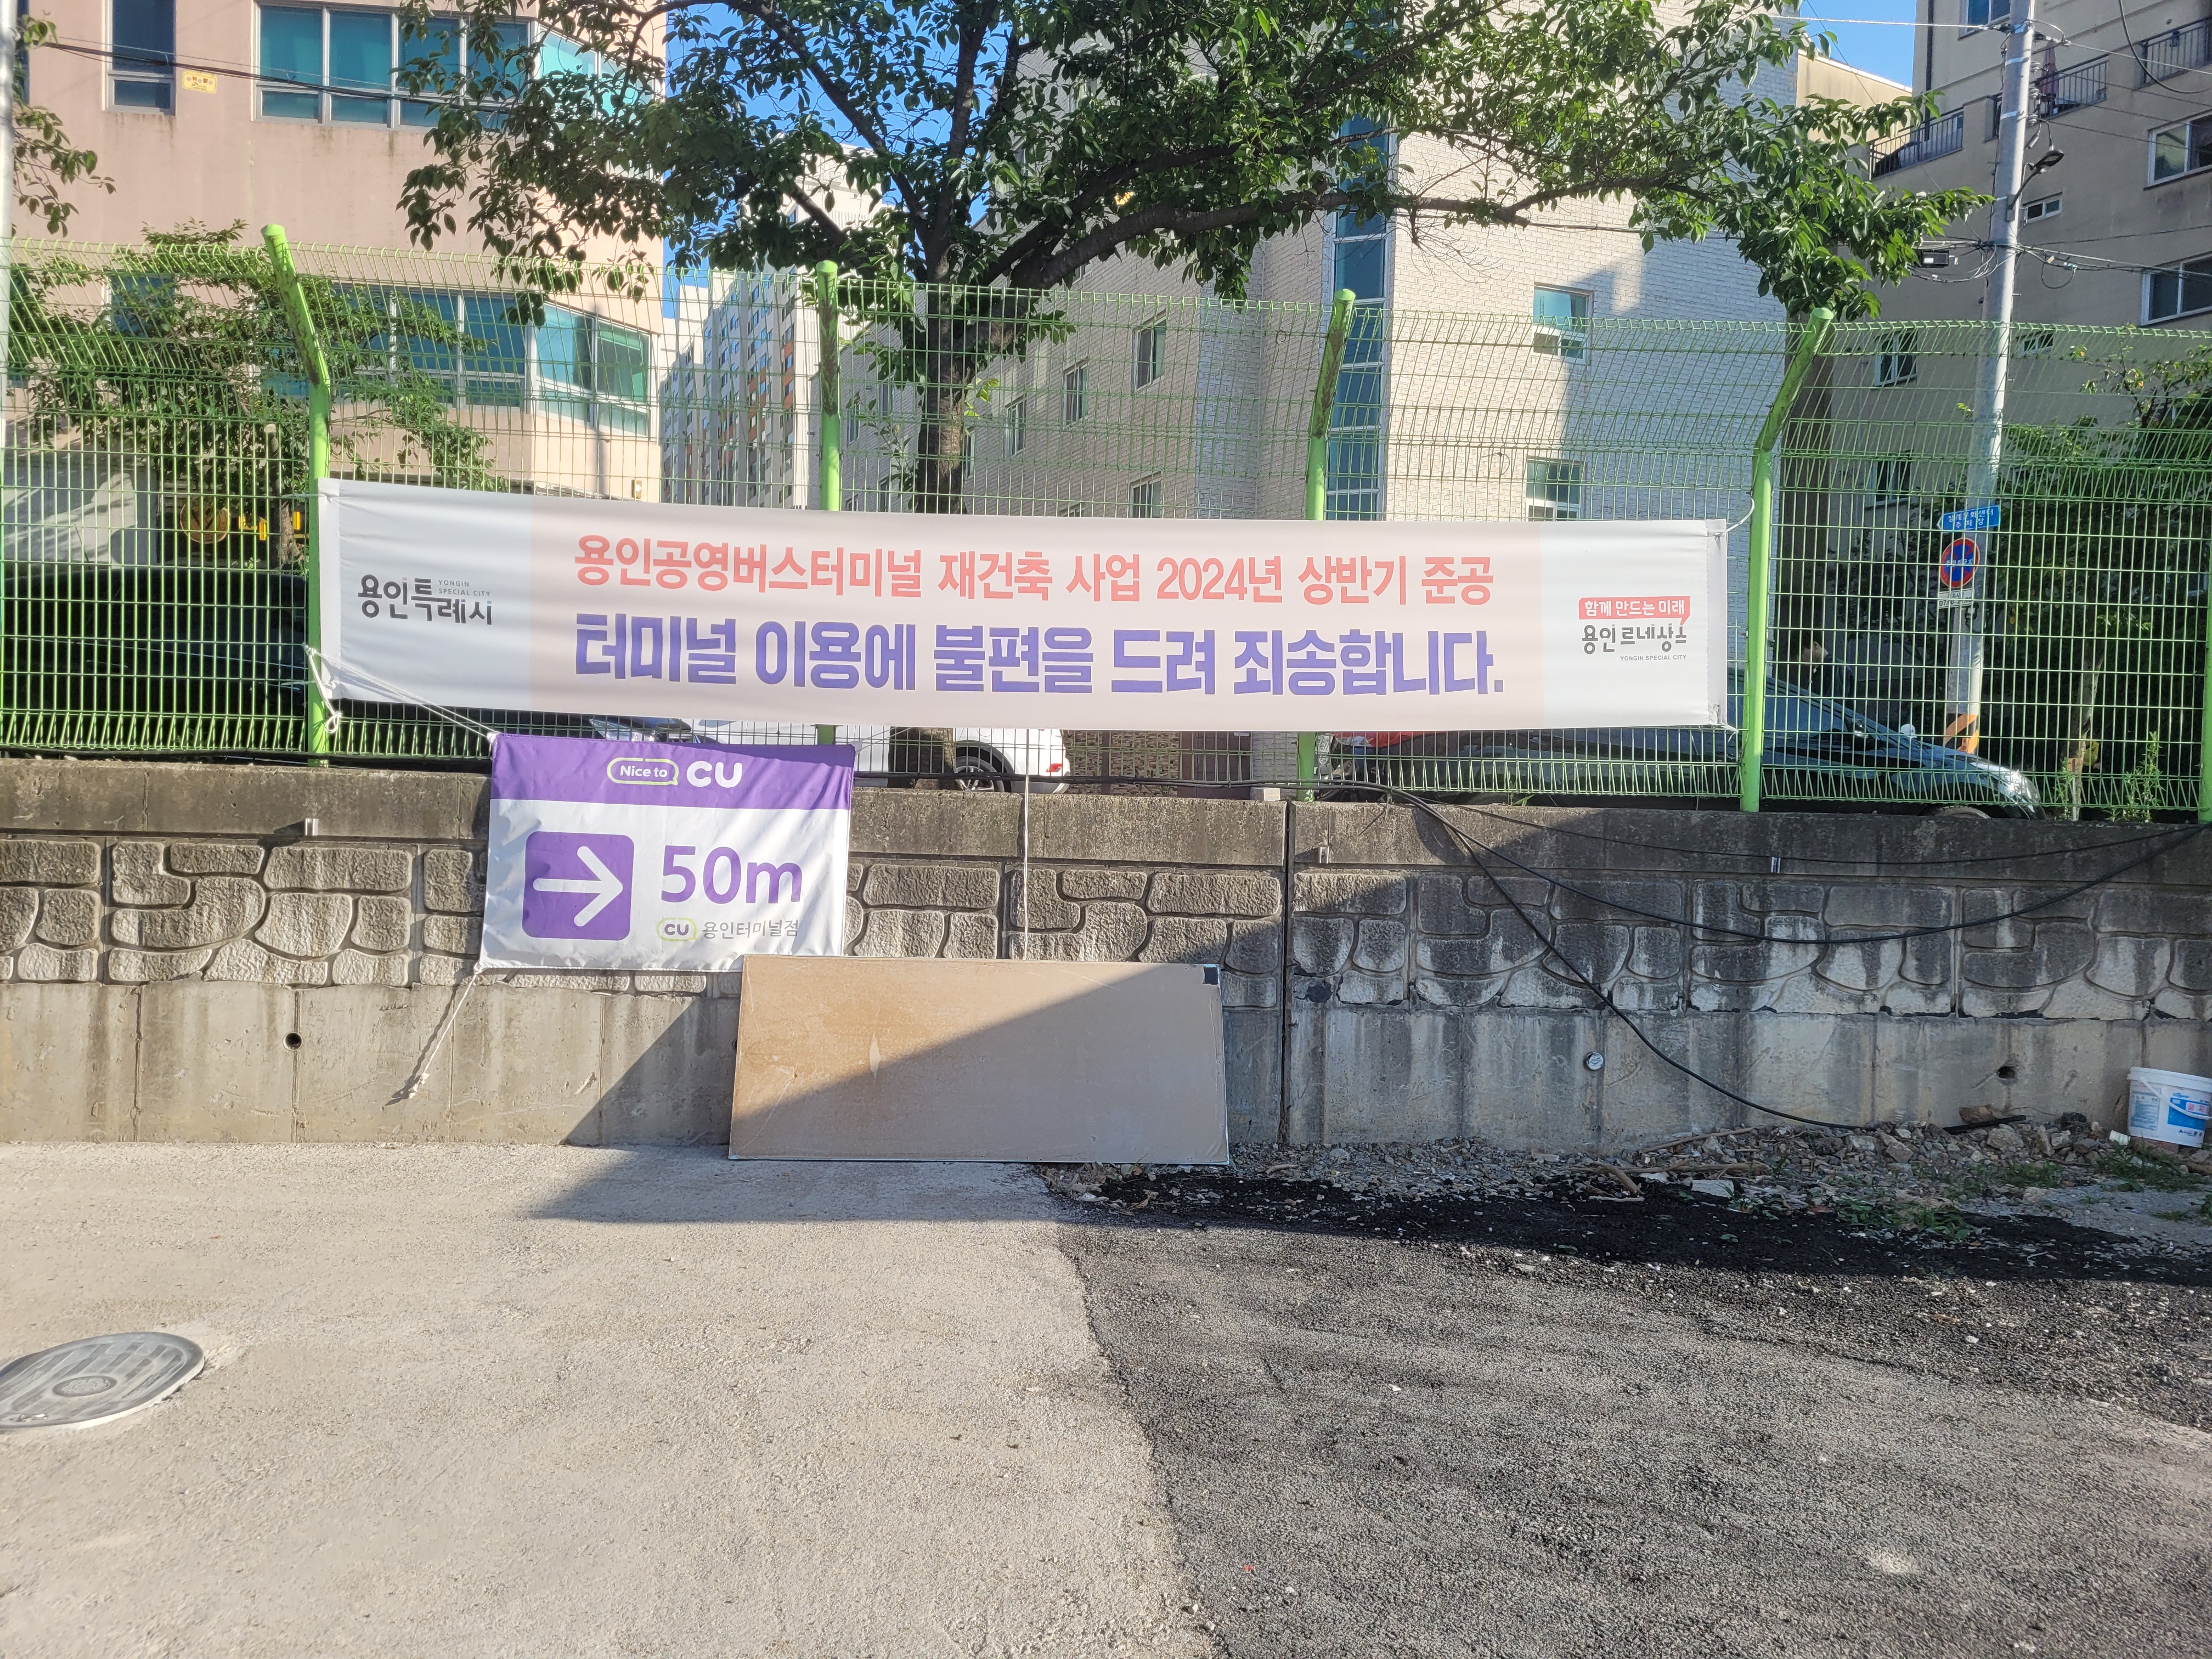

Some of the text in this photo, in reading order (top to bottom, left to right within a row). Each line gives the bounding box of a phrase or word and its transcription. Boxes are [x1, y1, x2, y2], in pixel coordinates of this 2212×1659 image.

[574, 534, 1494, 605] 용인공영버스터미널 재건축 사업 2024년 상반기 준공
[357, 574, 492, 625] 용인특례시
[1584, 599, 1685, 617] 함께 만드는 미래
[575, 614, 1504, 695] 터미널 이용에 불편을 드려 죄송합니다.
[620, 760, 742, 788] Nice to CU
[662, 845, 803, 904] 50m
[664, 919, 799, 940] CU 용인터미널점
